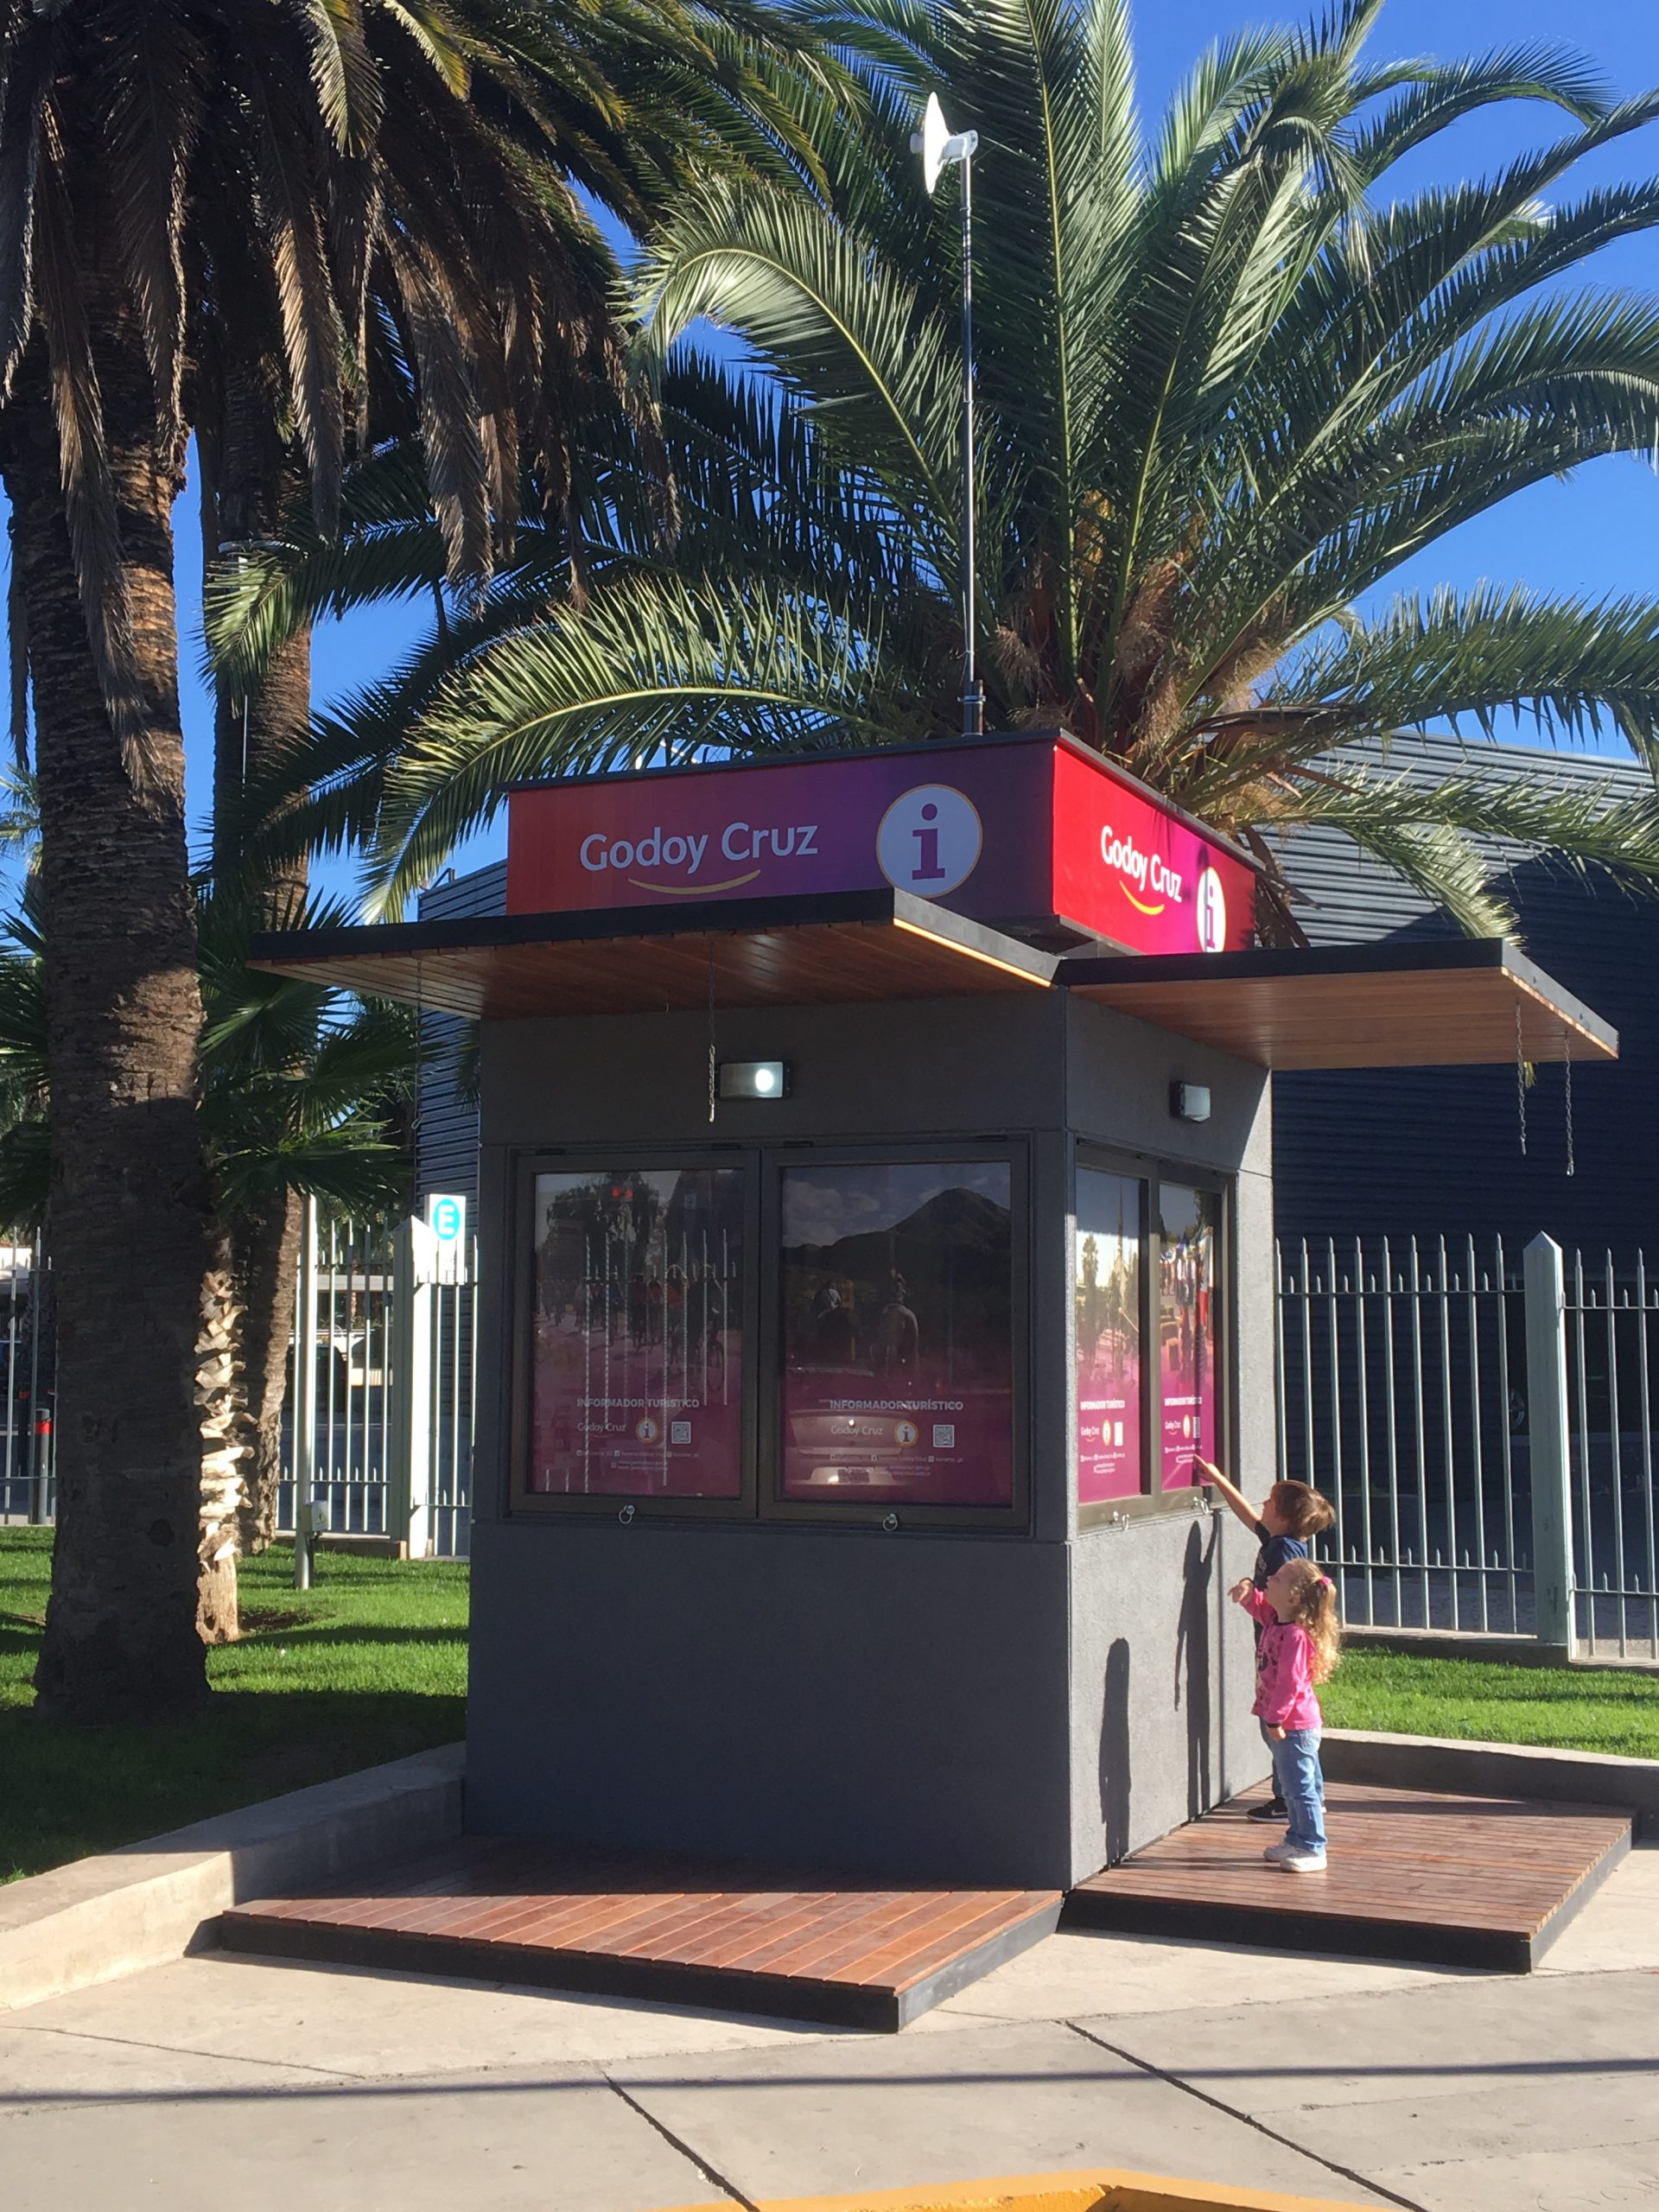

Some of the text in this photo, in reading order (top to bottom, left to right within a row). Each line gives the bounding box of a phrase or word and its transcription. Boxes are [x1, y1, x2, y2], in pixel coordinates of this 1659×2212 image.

[580, 822, 818, 874] Godoy Cruz
[1101, 825, 1182, 903] Godoy Cruz
[438, 1205, 455, 1235] E
[576, 1397, 645, 1408] INFORMADOR
[830, 1398, 964, 1411] INFORMADOR TURÍSTICO
[830, 1425, 884, 1436] Godoy Cruz
